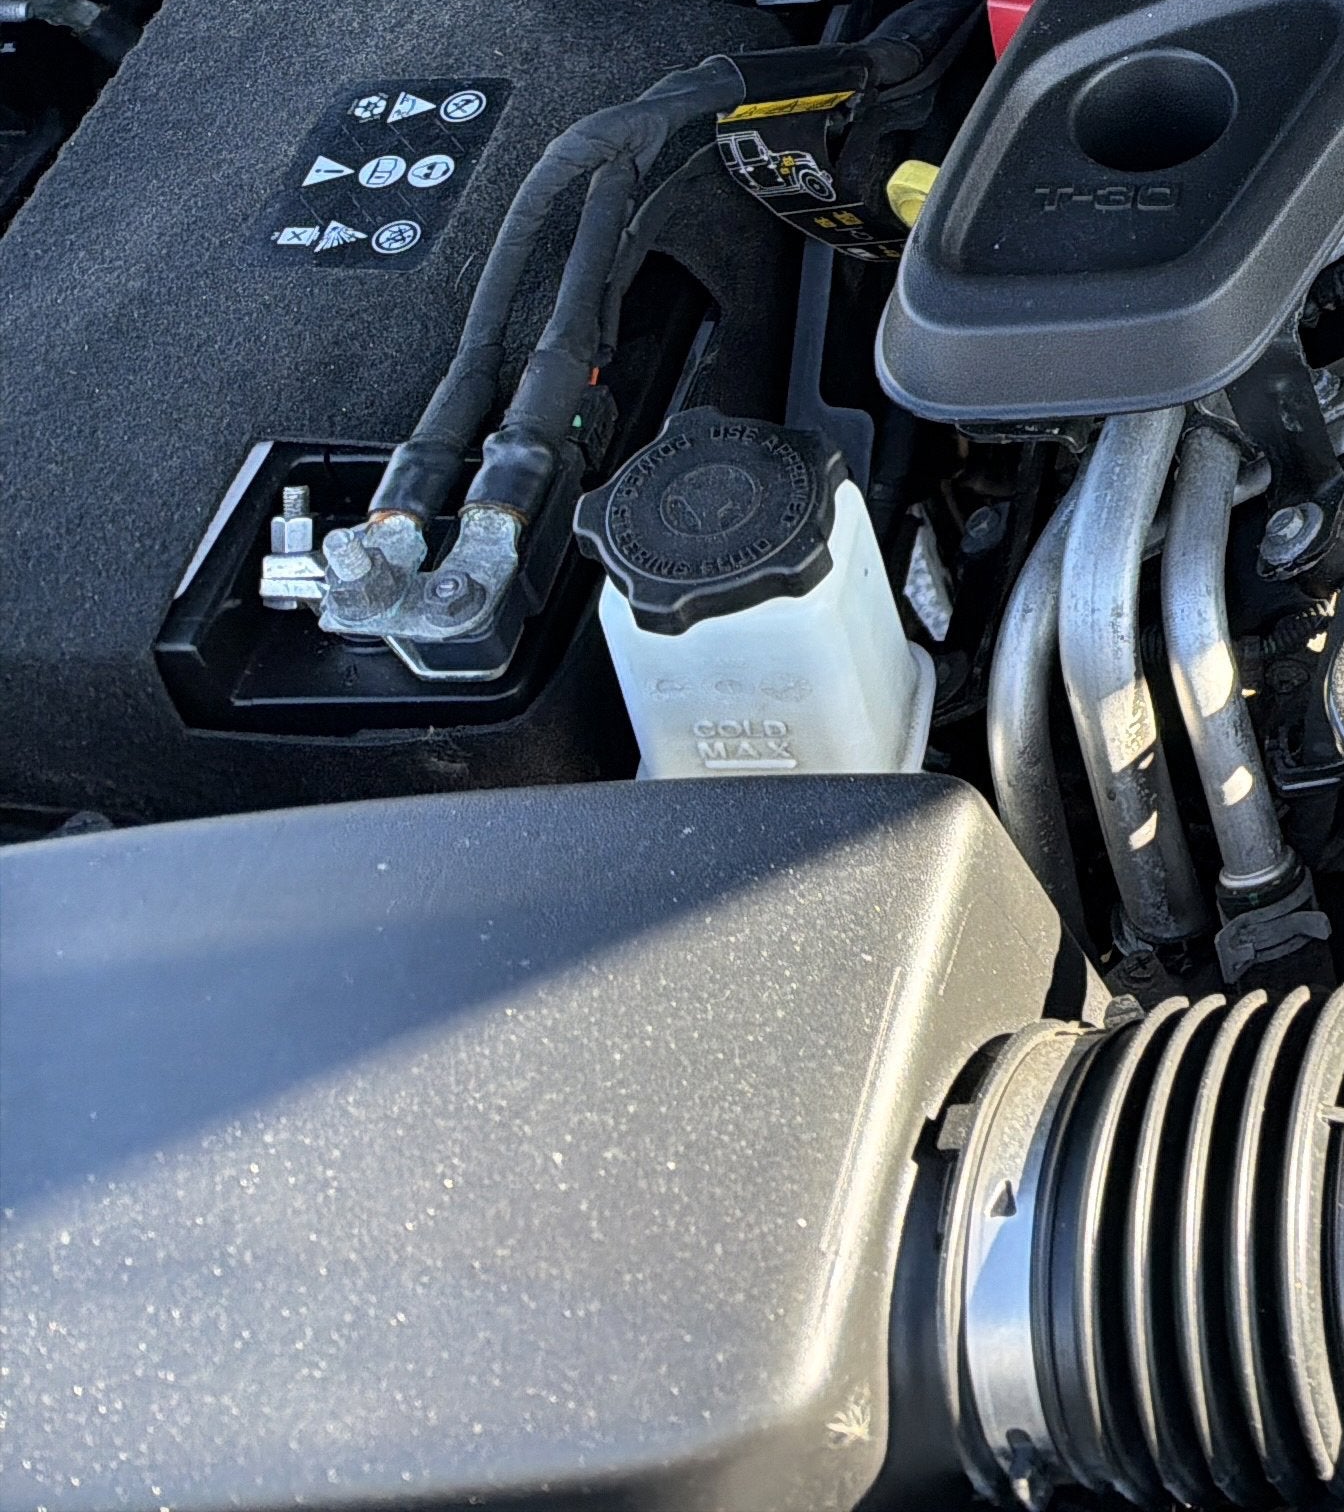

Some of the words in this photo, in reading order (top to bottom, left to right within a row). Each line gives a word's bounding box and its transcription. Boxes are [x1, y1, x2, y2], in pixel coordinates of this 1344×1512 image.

[709, 424, 760, 444] USE
[761, 435, 810, 529] APPROVED
[699, 538, 773, 576] FLUID
[693, 719, 788, 738] COLD
[697, 741, 792, 760] MAX
